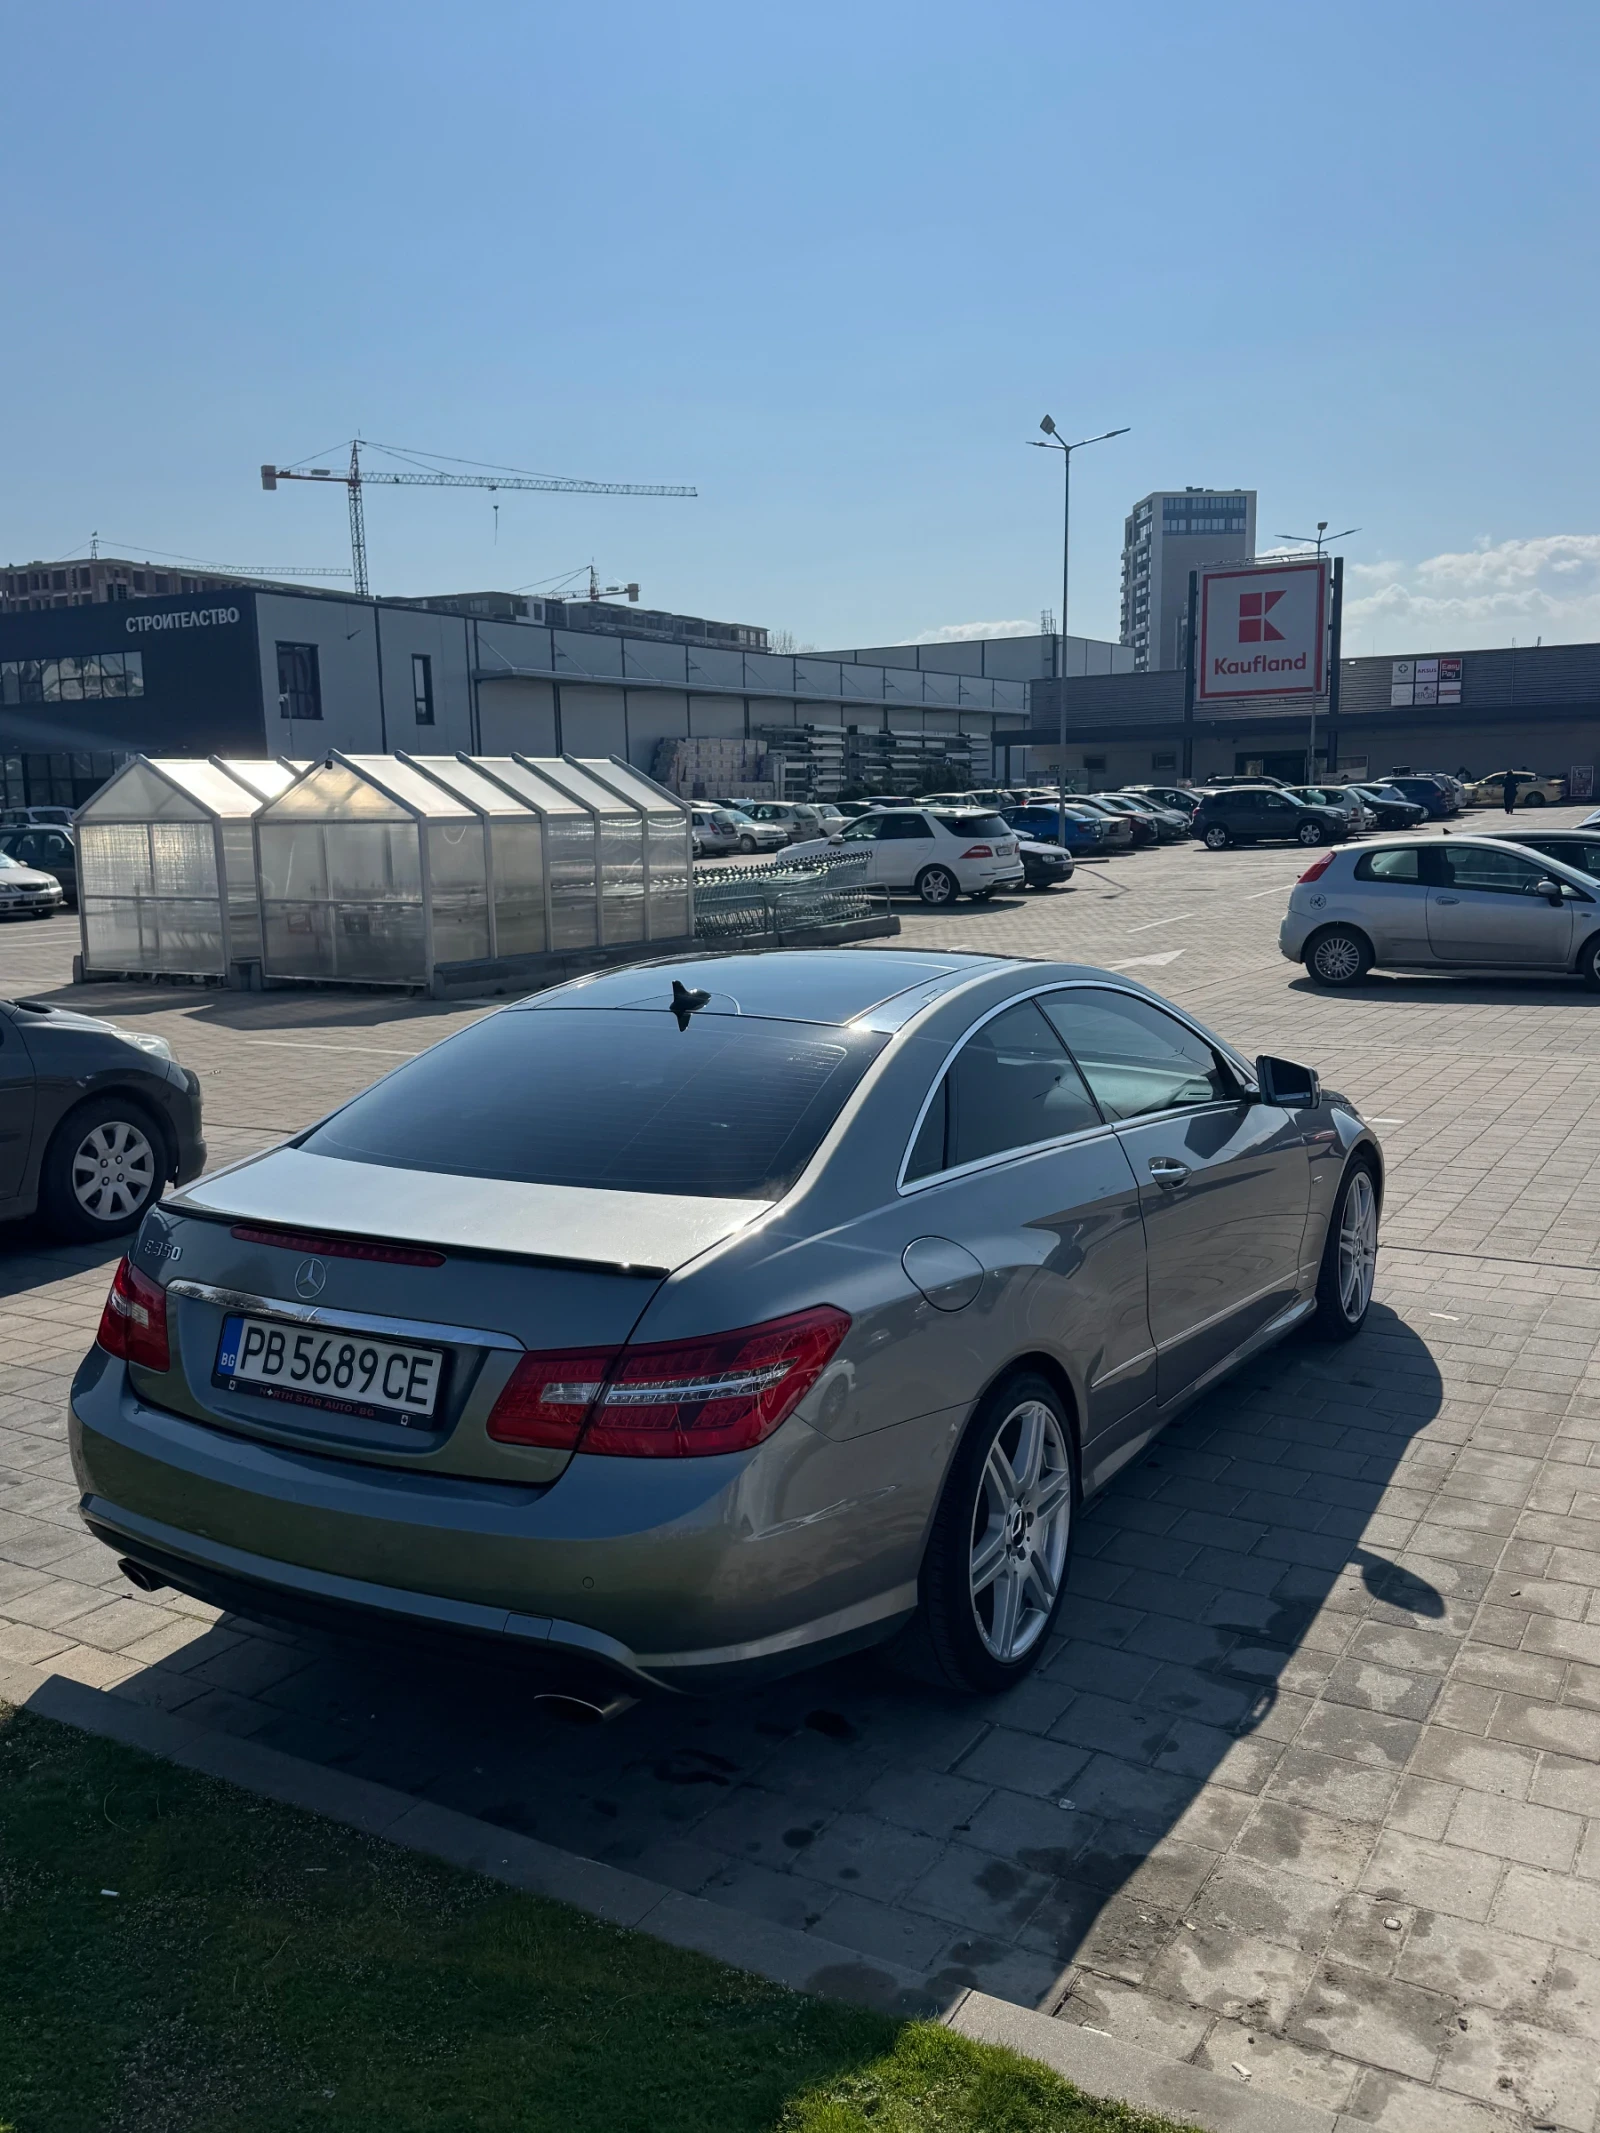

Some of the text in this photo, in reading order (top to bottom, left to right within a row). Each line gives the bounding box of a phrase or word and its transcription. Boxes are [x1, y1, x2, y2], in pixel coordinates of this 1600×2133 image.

[125, 607, 240, 633] СТРОИТЕЛСТВО
[1214, 652, 1307, 675] Kaufland
[1441, 663, 1460, 671] Easy
[1441, 670, 1456, 678] Pay
[220, 1352, 236, 1367] BG
[295, 1394, 322, 1407] STAR
